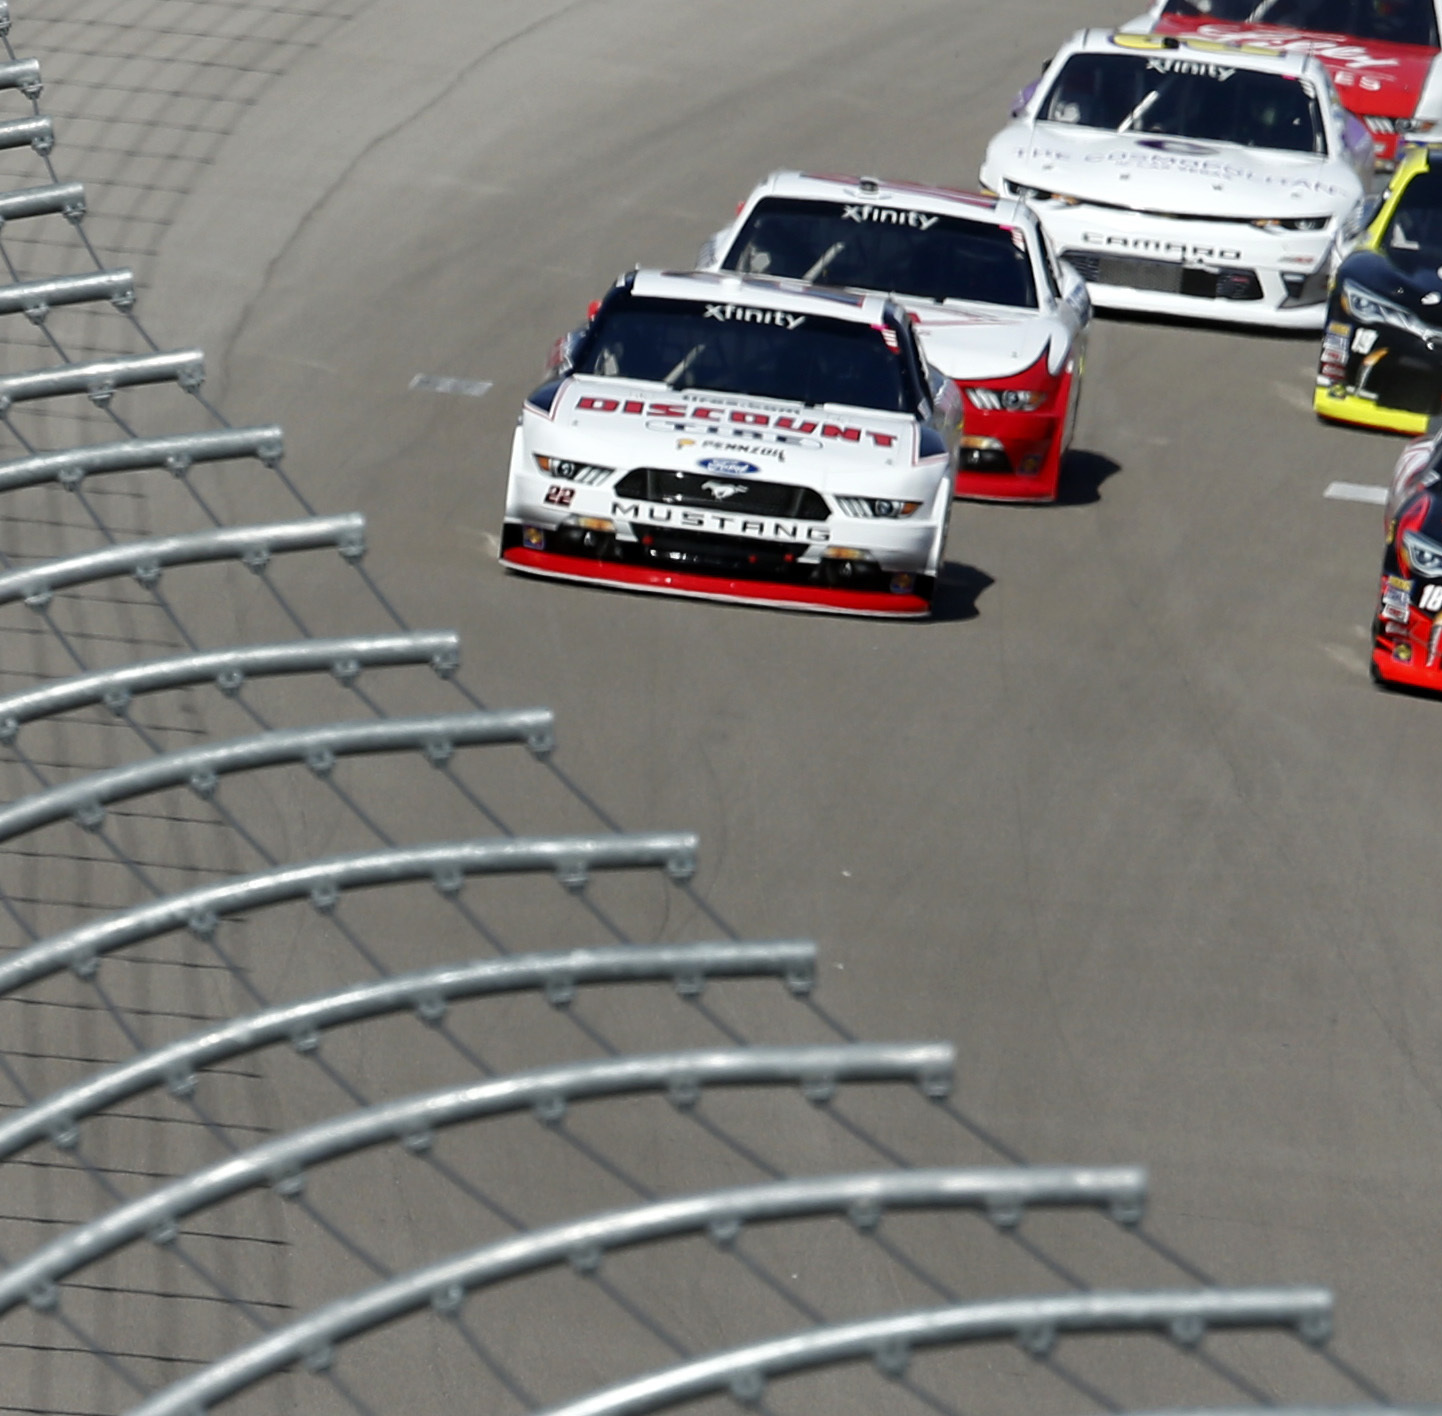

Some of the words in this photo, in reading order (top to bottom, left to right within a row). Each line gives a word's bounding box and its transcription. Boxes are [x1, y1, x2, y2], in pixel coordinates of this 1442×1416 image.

[841, 203, 939, 232] xfinity
[703, 303, 806, 330] xfinity
[576, 397, 898, 449] DISCOUNT
[543, 485, 576, 509] 22
[610, 502, 832, 542] MUSTANG
